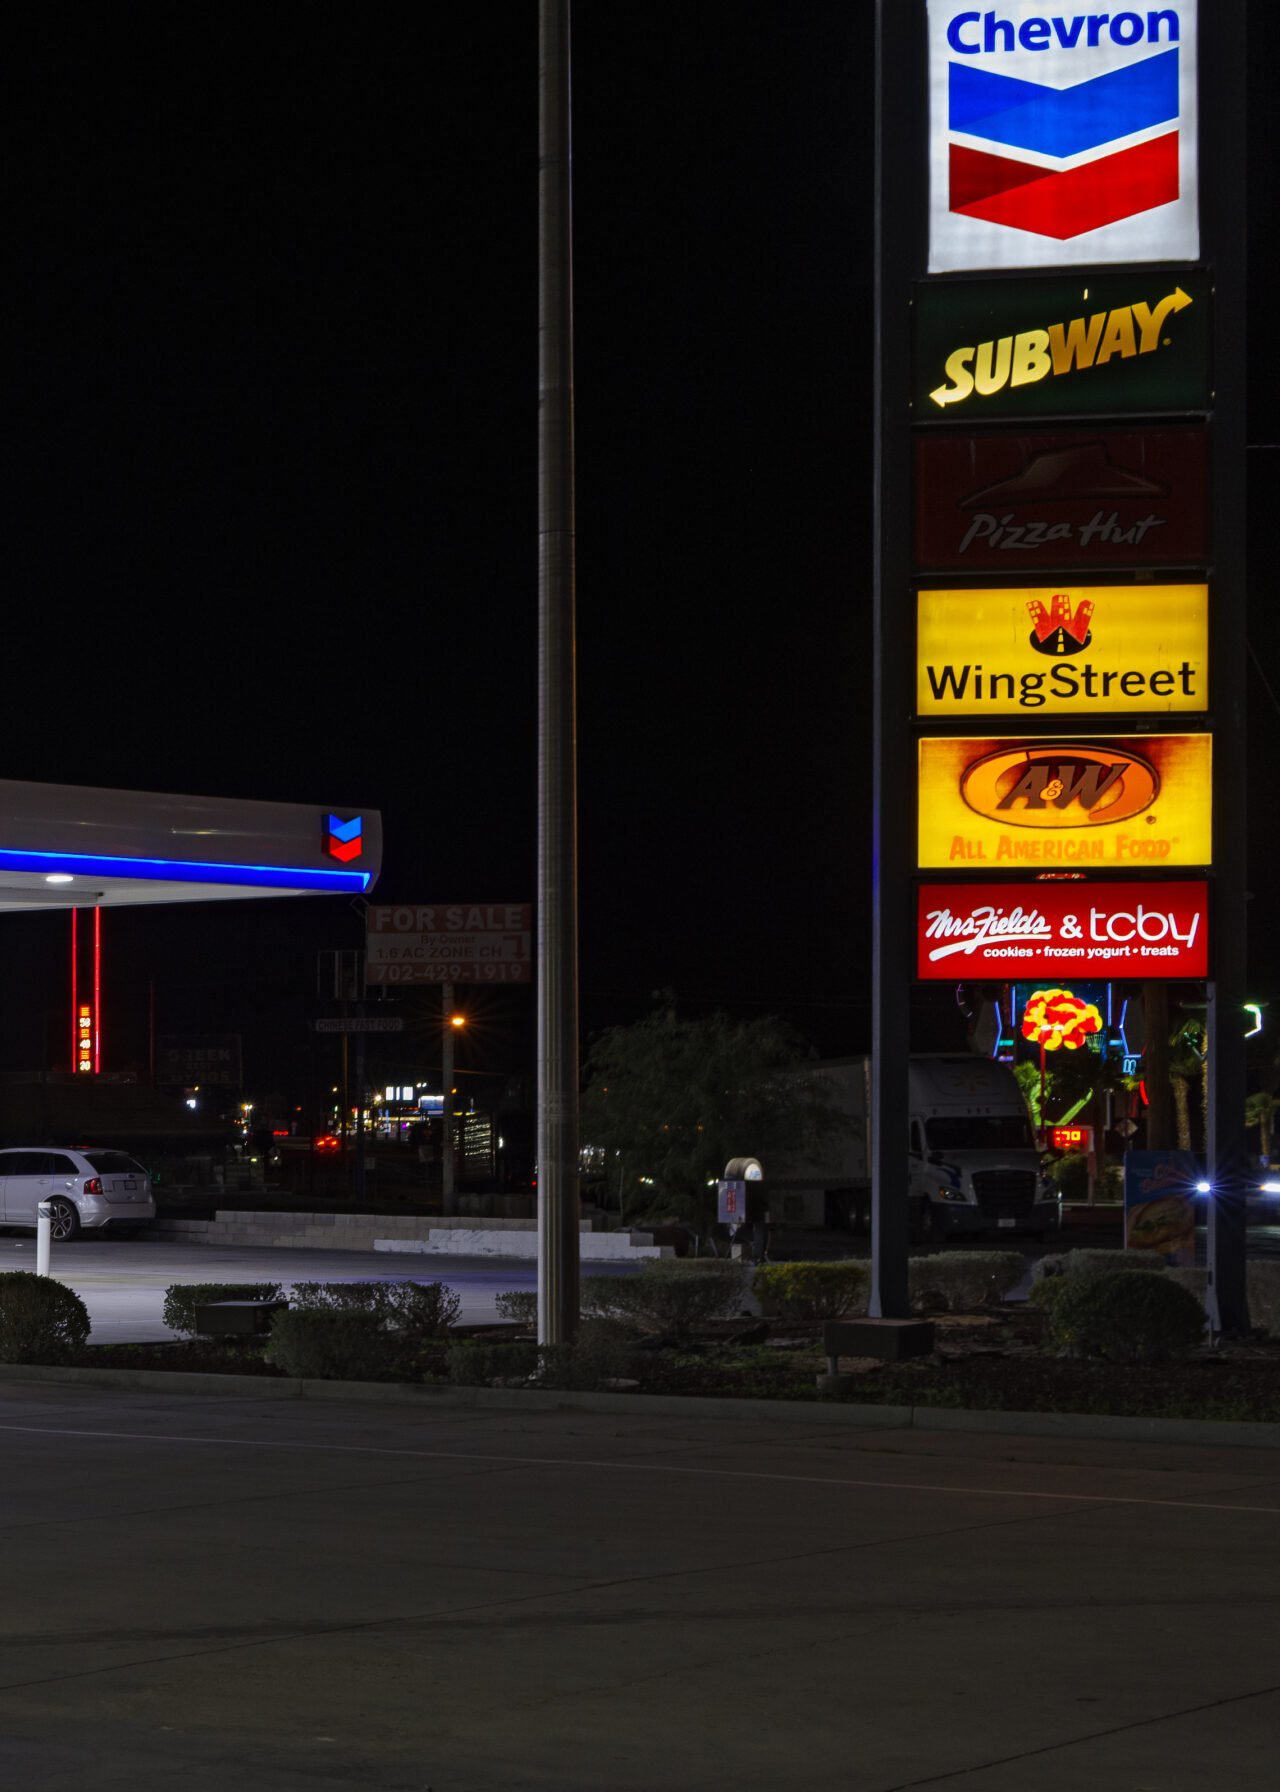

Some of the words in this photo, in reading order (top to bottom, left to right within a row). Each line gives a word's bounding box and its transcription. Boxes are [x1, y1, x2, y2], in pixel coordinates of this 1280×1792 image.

[946, 9, 1180, 55] Chevron
[929, 286, 1194, 409] SUBWAY
[958, 513, 1074, 556] Pizza
[1078, 510, 1168, 547] Hut
[927, 662, 1197, 707] WingStreet
[995, 762, 1130, 811] A&W
[949, 835, 986, 861] ALL
[996, 835, 1104, 861] AMERICAN
[1116, 834, 1171, 859] FOOD
[376, 908, 436, 931] FOR
[447, 908, 523, 931] SALE
[1060, 914, 1084, 939] &
[1090, 904, 1200, 948] tcby
[402, 947, 425, 959] AC
[429, 946, 473, 959] ZONE
[478, 946, 503, 958] CH
[420, 934, 437, 947] By
[439, 934, 476, 946] Owner
[983, 945, 1034, 959] cookies
[1044, 945, 1085, 958] frozen
[1087, 946, 1130, 960] yogurt
[1141, 945, 1180, 957] treats
[375, 964, 523, 982] 702-429-1919
